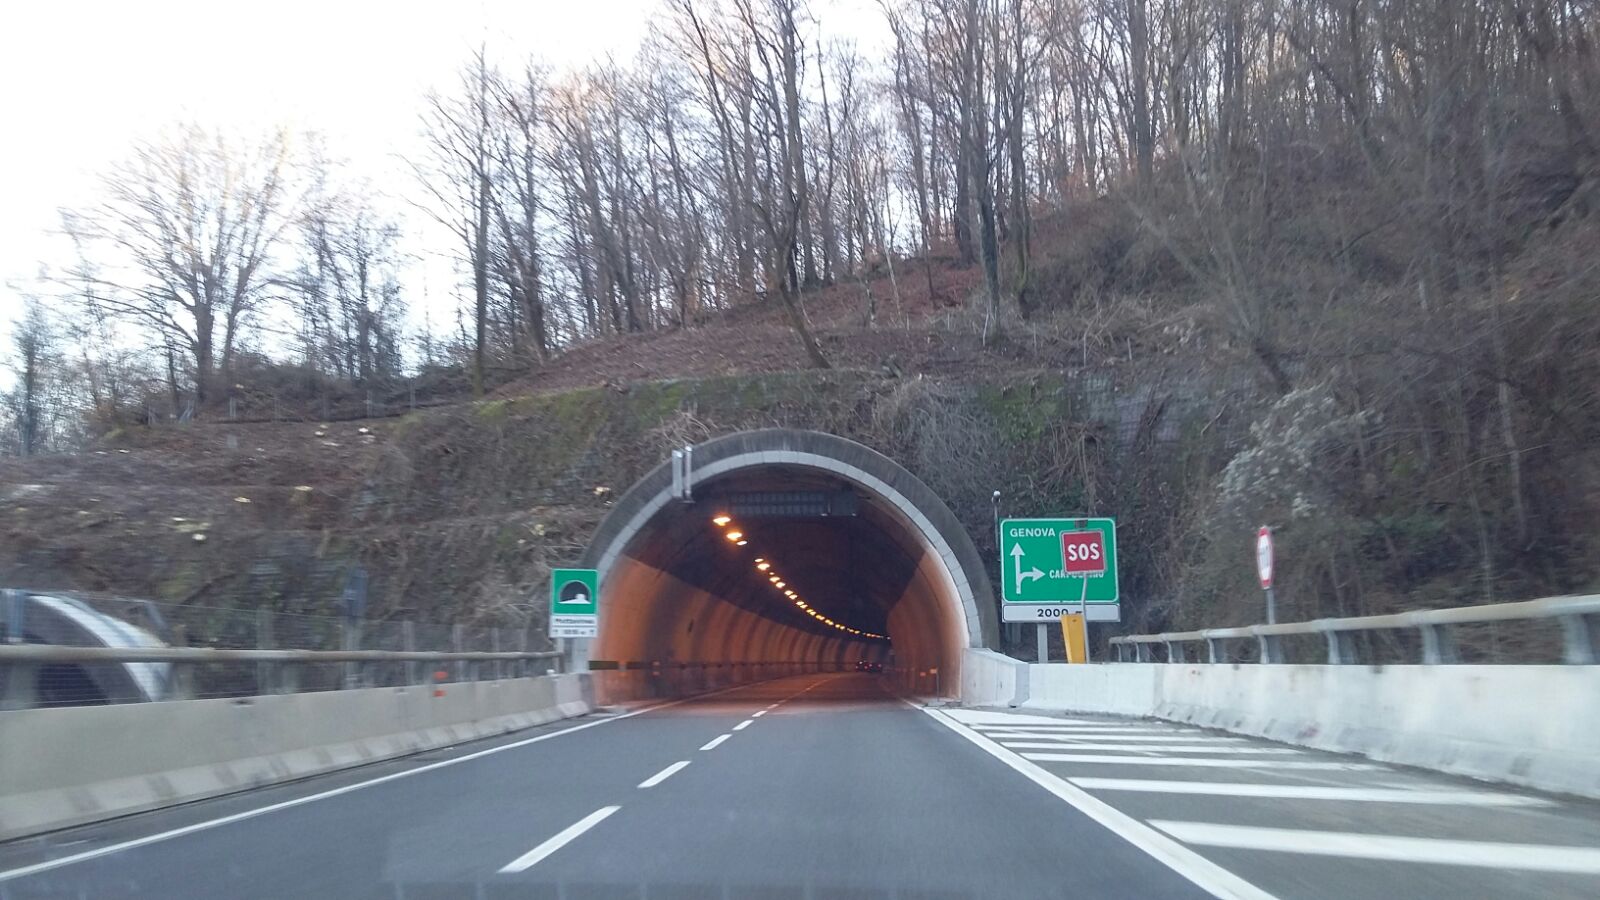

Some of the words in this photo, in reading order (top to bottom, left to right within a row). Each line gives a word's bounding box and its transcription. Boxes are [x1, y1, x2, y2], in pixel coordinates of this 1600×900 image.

[1009, 527, 1056, 538] GENOVA
[1067, 542, 1100, 562] SOS
[1036, 608, 1069, 618] 2000
